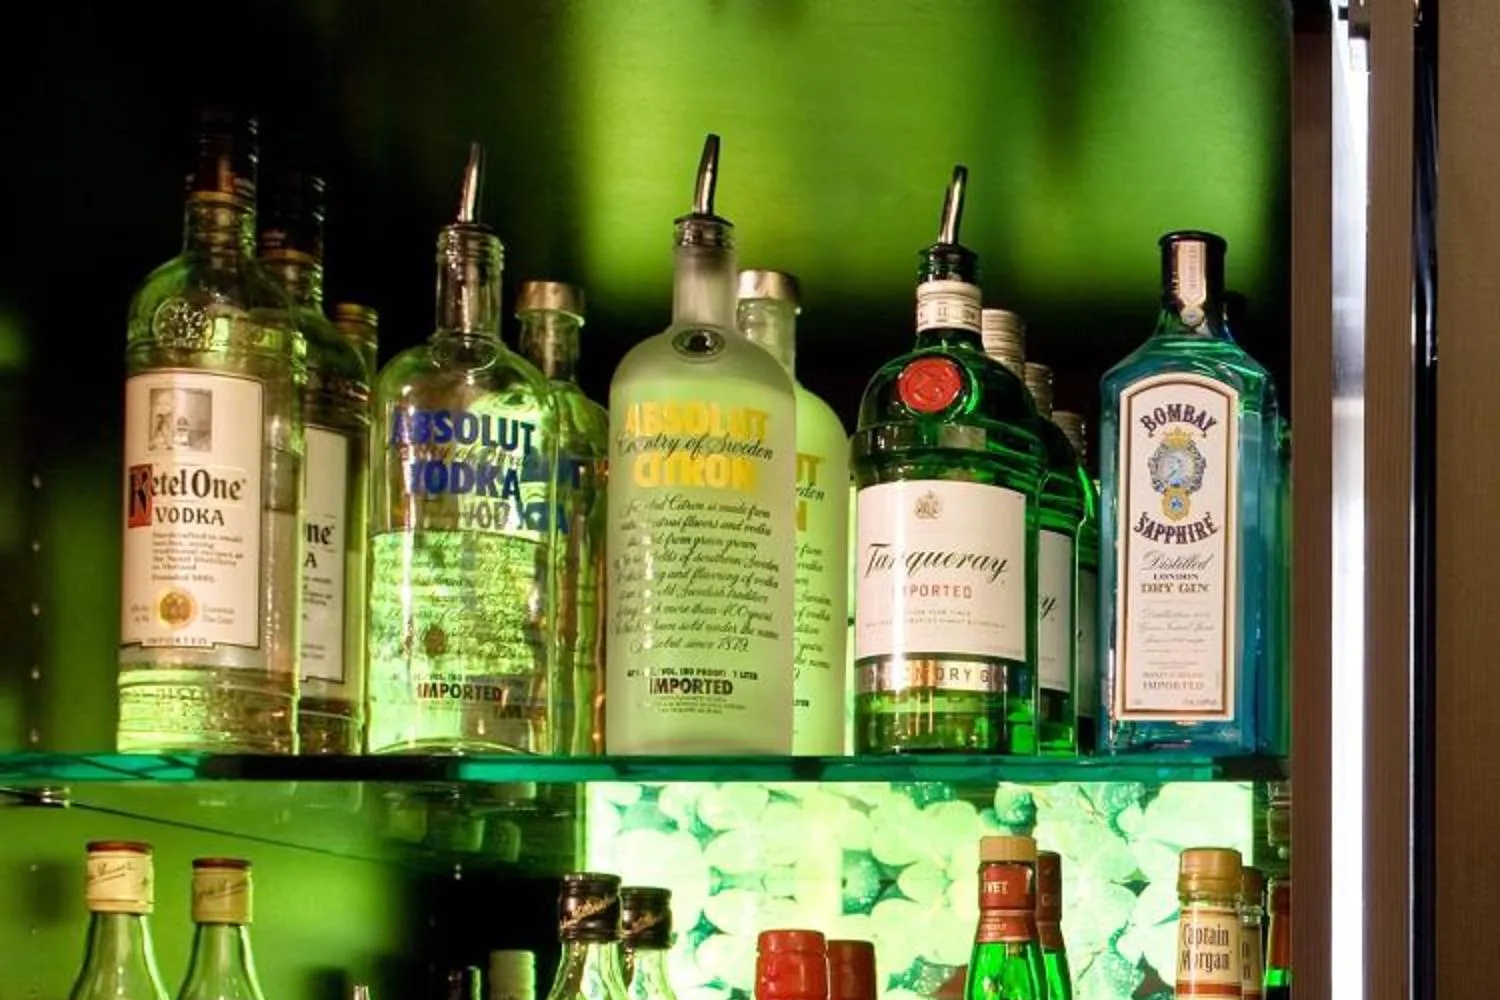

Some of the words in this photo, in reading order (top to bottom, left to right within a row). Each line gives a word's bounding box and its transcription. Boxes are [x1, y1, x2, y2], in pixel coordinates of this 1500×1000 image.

[391, 410, 536, 454] ABSOLUT
[624, 401, 770, 440] ABSOLUT
[1139, 403, 1217, 438] BOMBAY
[706, 435, 774, 460] Sweden
[634, 450, 758, 494] CITRON
[129, 467, 188, 518] Ketel
[192, 469, 242, 501] One
[155, 507, 225, 527] VODKA
[1133, 512, 1218, 544] SAPPHIRE
[1141, 550, 1215, 571] Distilled
[902, 584, 973, 600] PORTED
[1141, 583, 1174, 594] DRY
[1178, 583, 1210, 593] GIN
[650, 676, 734, 696] IMPORTED
[935, 667, 973, 682] DRY
[417, 683, 503, 701] IMPORTED
[1183, 922, 1230, 950] Captain
